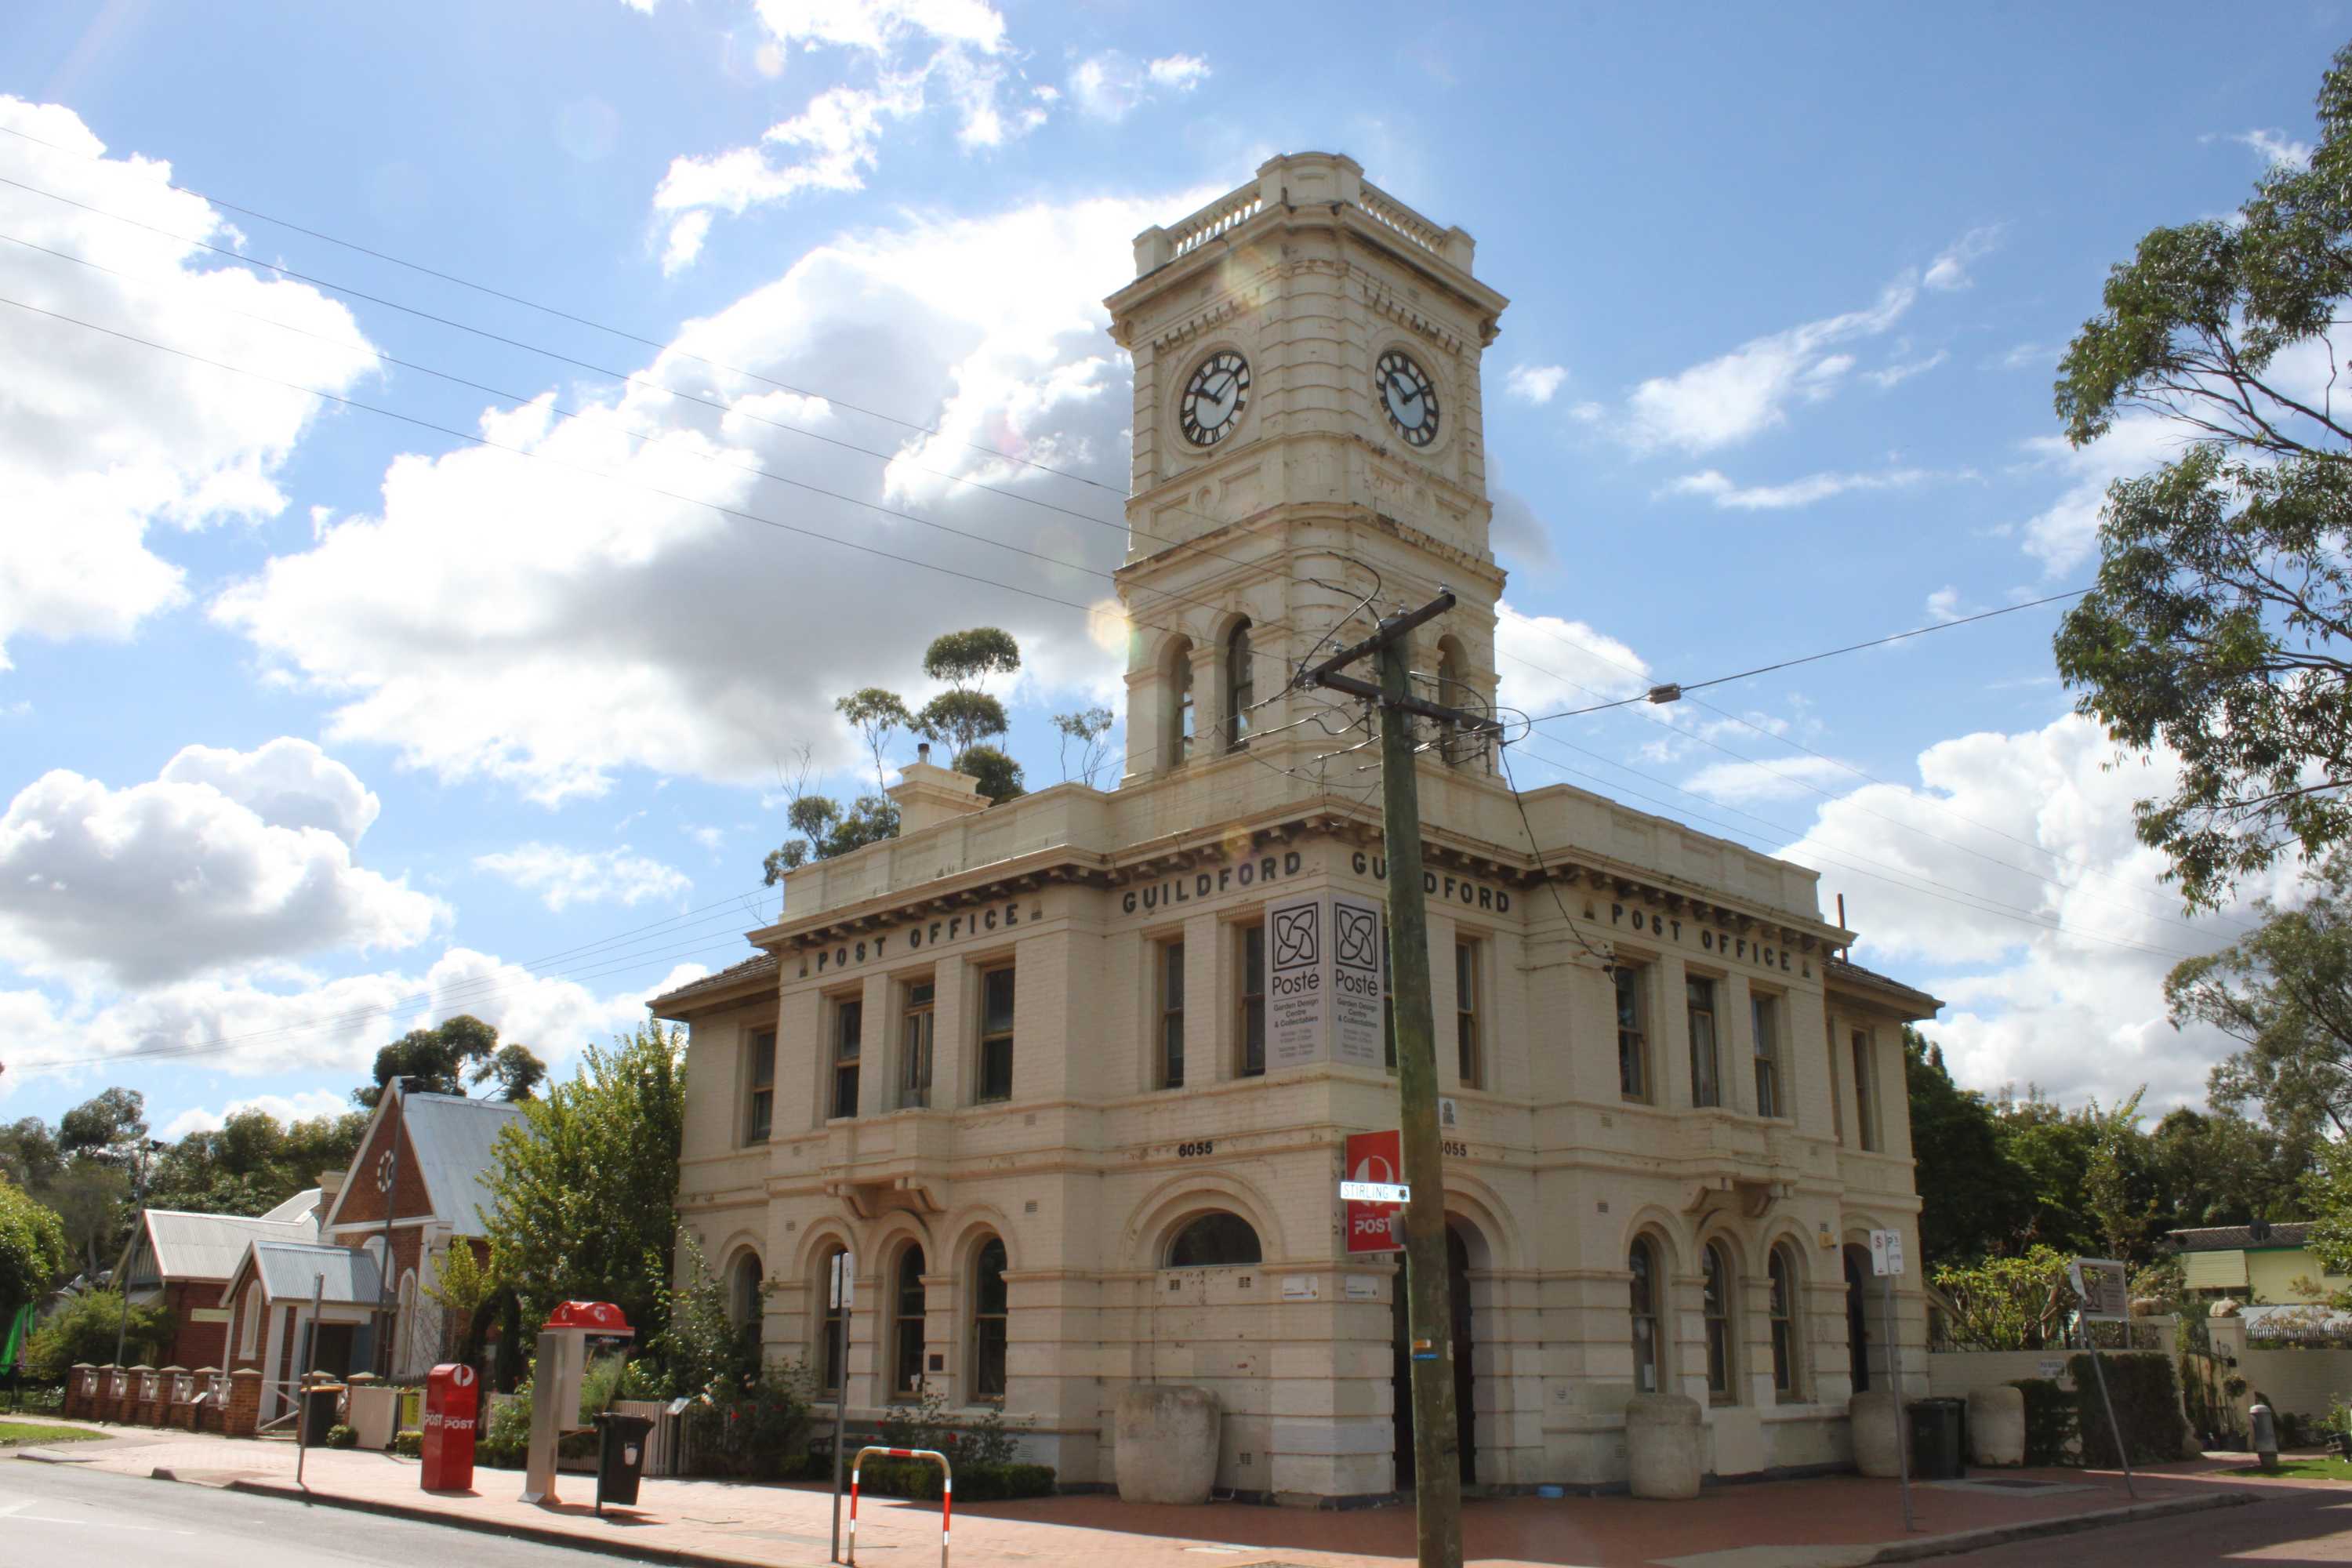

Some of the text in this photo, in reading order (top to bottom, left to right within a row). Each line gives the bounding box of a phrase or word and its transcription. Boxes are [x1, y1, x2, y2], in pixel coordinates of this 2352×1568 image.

[1122, 851, 1301, 914] GUILDFORD
[1352, 851, 1510, 913] GUDFORD
[818, 903, 1019, 972] POST OFFICE
[1611, 903, 1791, 971] POST OFFICE
[1272, 967, 1319, 996] Posté
[1335, 969, 1378, 997] Posté
[1298, 999, 1319, 1007] Design
[1179, 1142, 1213, 1158] 6055
[1344, 1184, 1389, 1200] STIRLING
[425, 1414, 443, 1426] POST
[445, 1419, 474, 1429] POST
